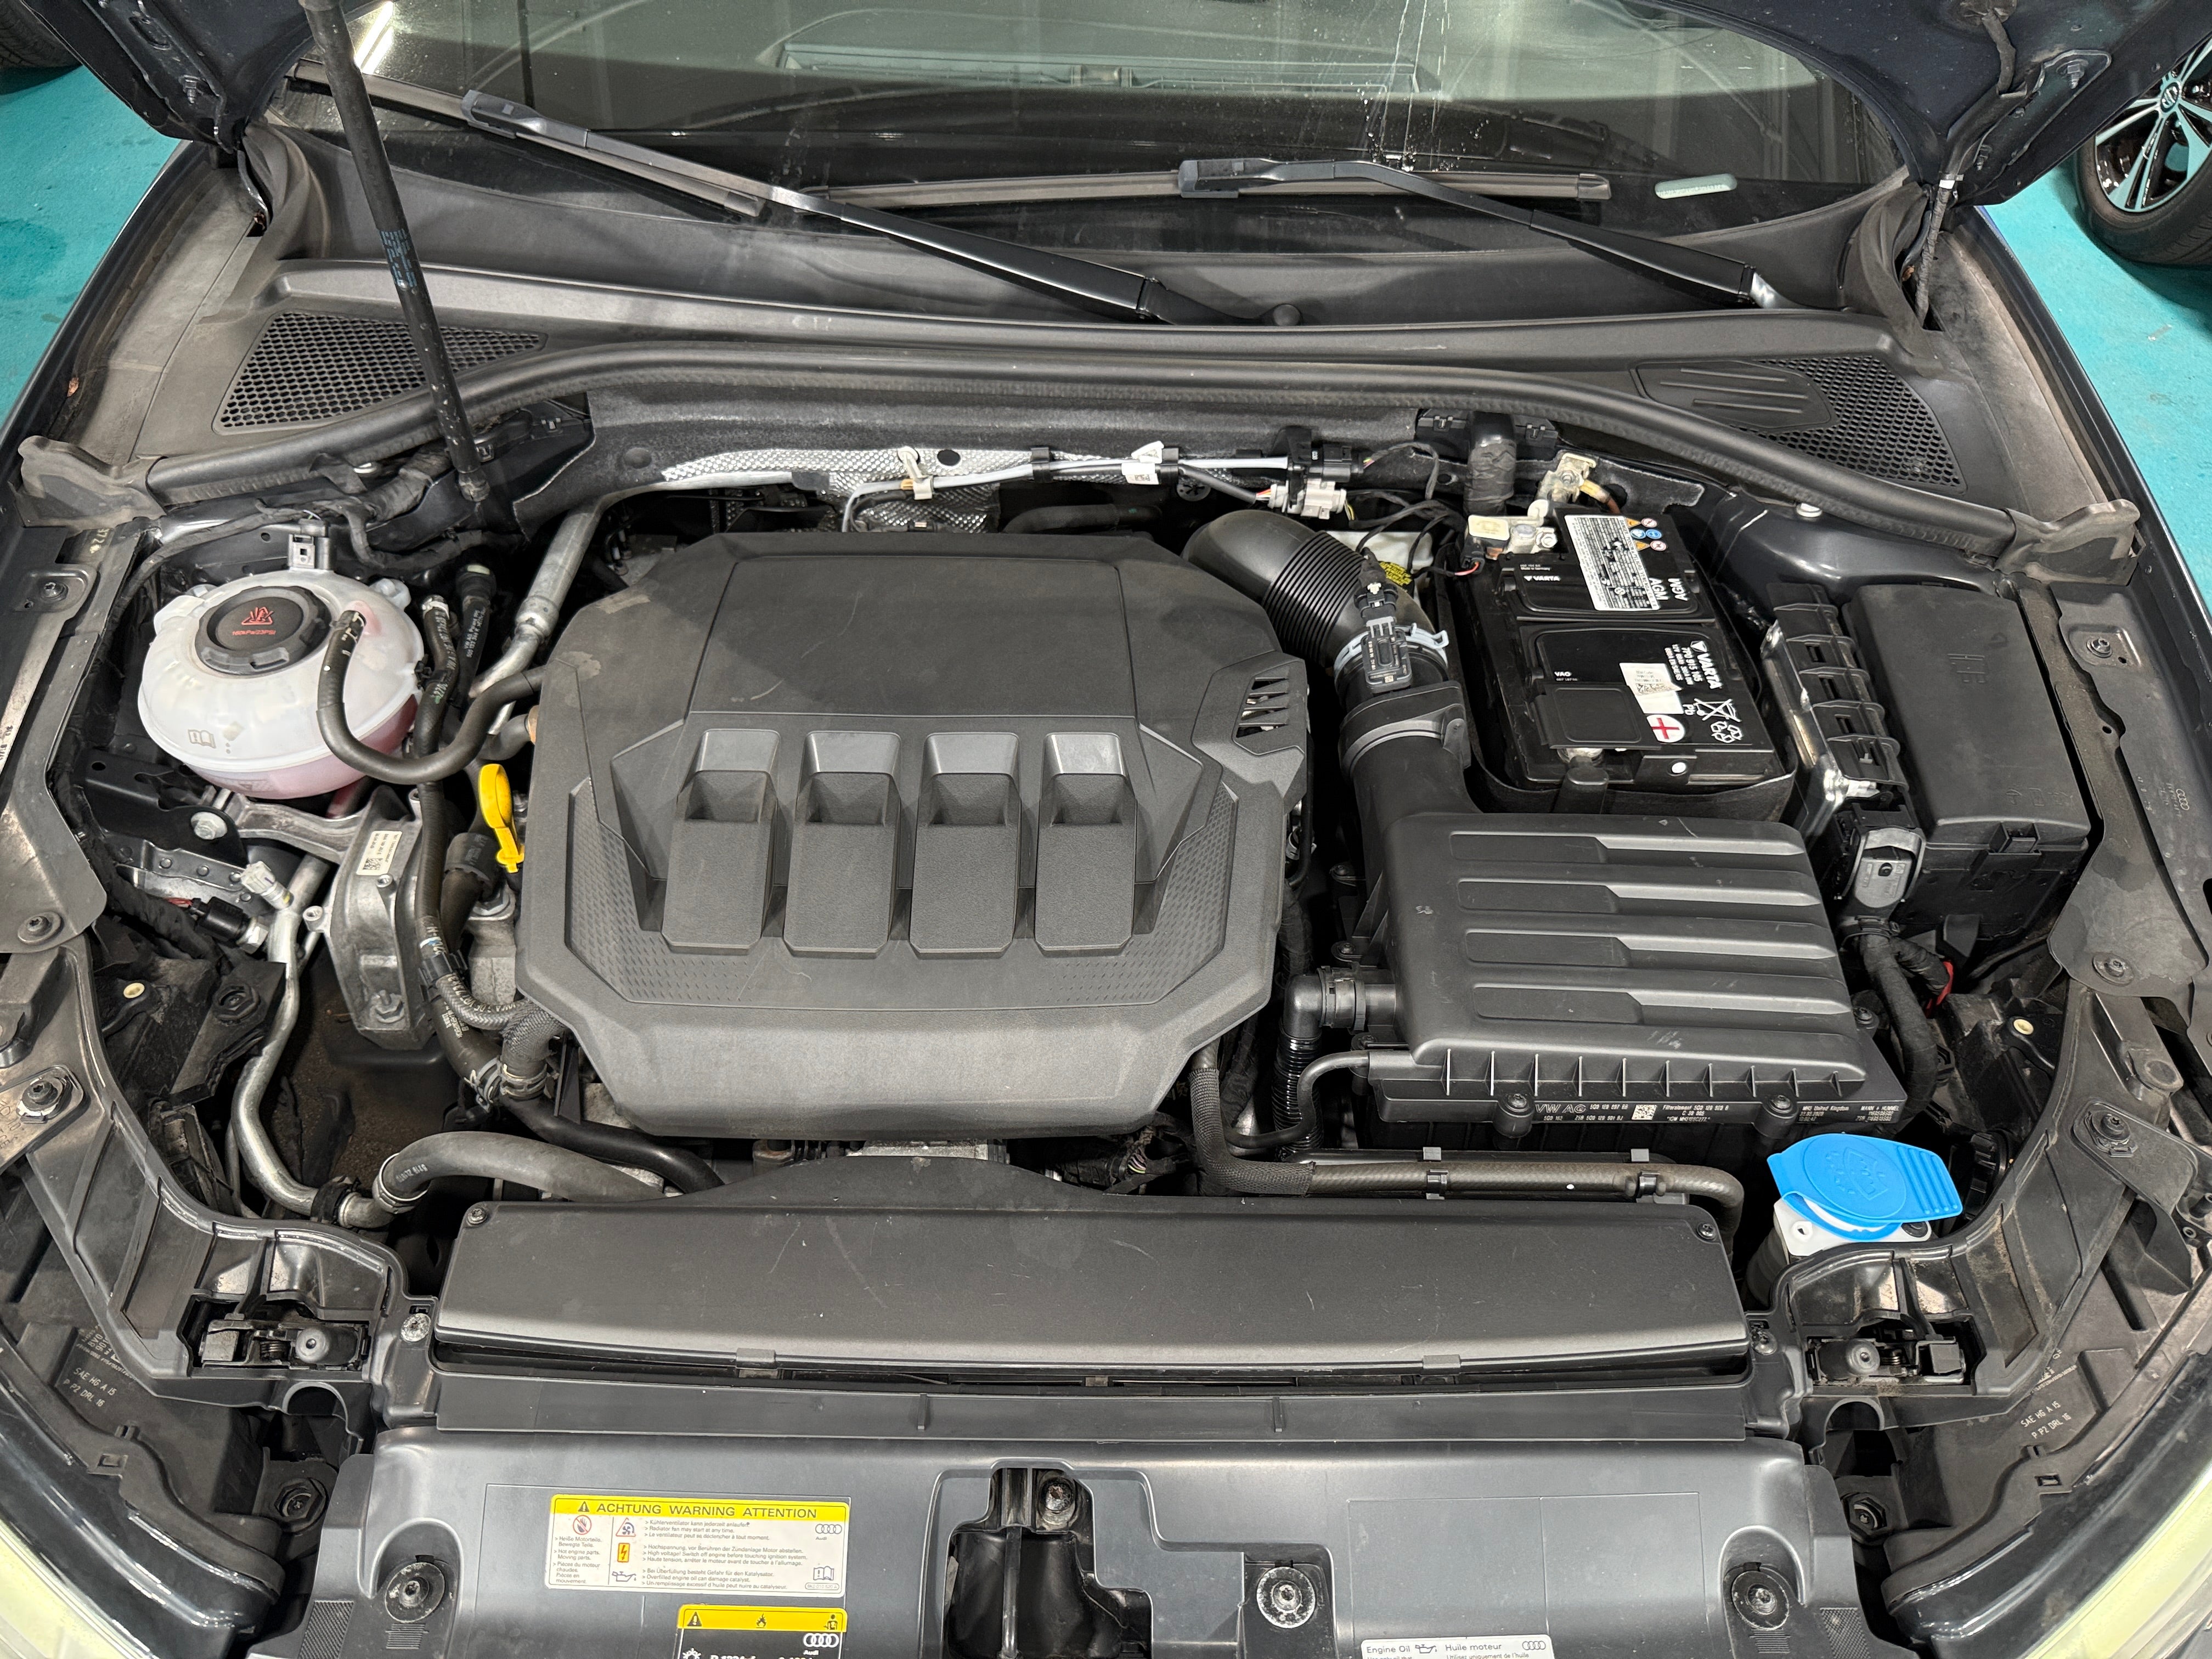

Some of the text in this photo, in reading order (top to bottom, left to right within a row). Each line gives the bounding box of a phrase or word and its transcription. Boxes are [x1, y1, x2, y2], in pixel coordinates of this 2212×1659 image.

[1649, 578, 1669, 601] AGM
[1668, 578, 1688, 601] AGM
[1681, 647, 1702, 682] 7P0 915 105
[1697, 653, 1723, 690] VARTA
[1683, 704, 1696, 715] Pb
[1536, 1104, 1587, 1114] VW AG
[74, 1367, 90, 1380] SAE
[89, 1376, 101, 1386] HG
[108, 1387, 117, 1396] 15
[70, 1383, 81, 1393] P2
[80, 1389, 95, 1402] DRL
[95, 1398, 105, 1407] 16
[2021, 1415, 2036, 1427] SAE
[2035, 1409, 2046, 1419] HG
[2052, 1401, 2061, 1409] 15
[2038, 1426, 2050, 1435] P2
[2047, 1419, 2063, 1430] DRL
[2062, 1413, 2072, 1421] 16
[596, 1503, 816, 1518] ACHTUNG WARNING ATTENTION
[1367, 1646, 1396, 1654] Engine
